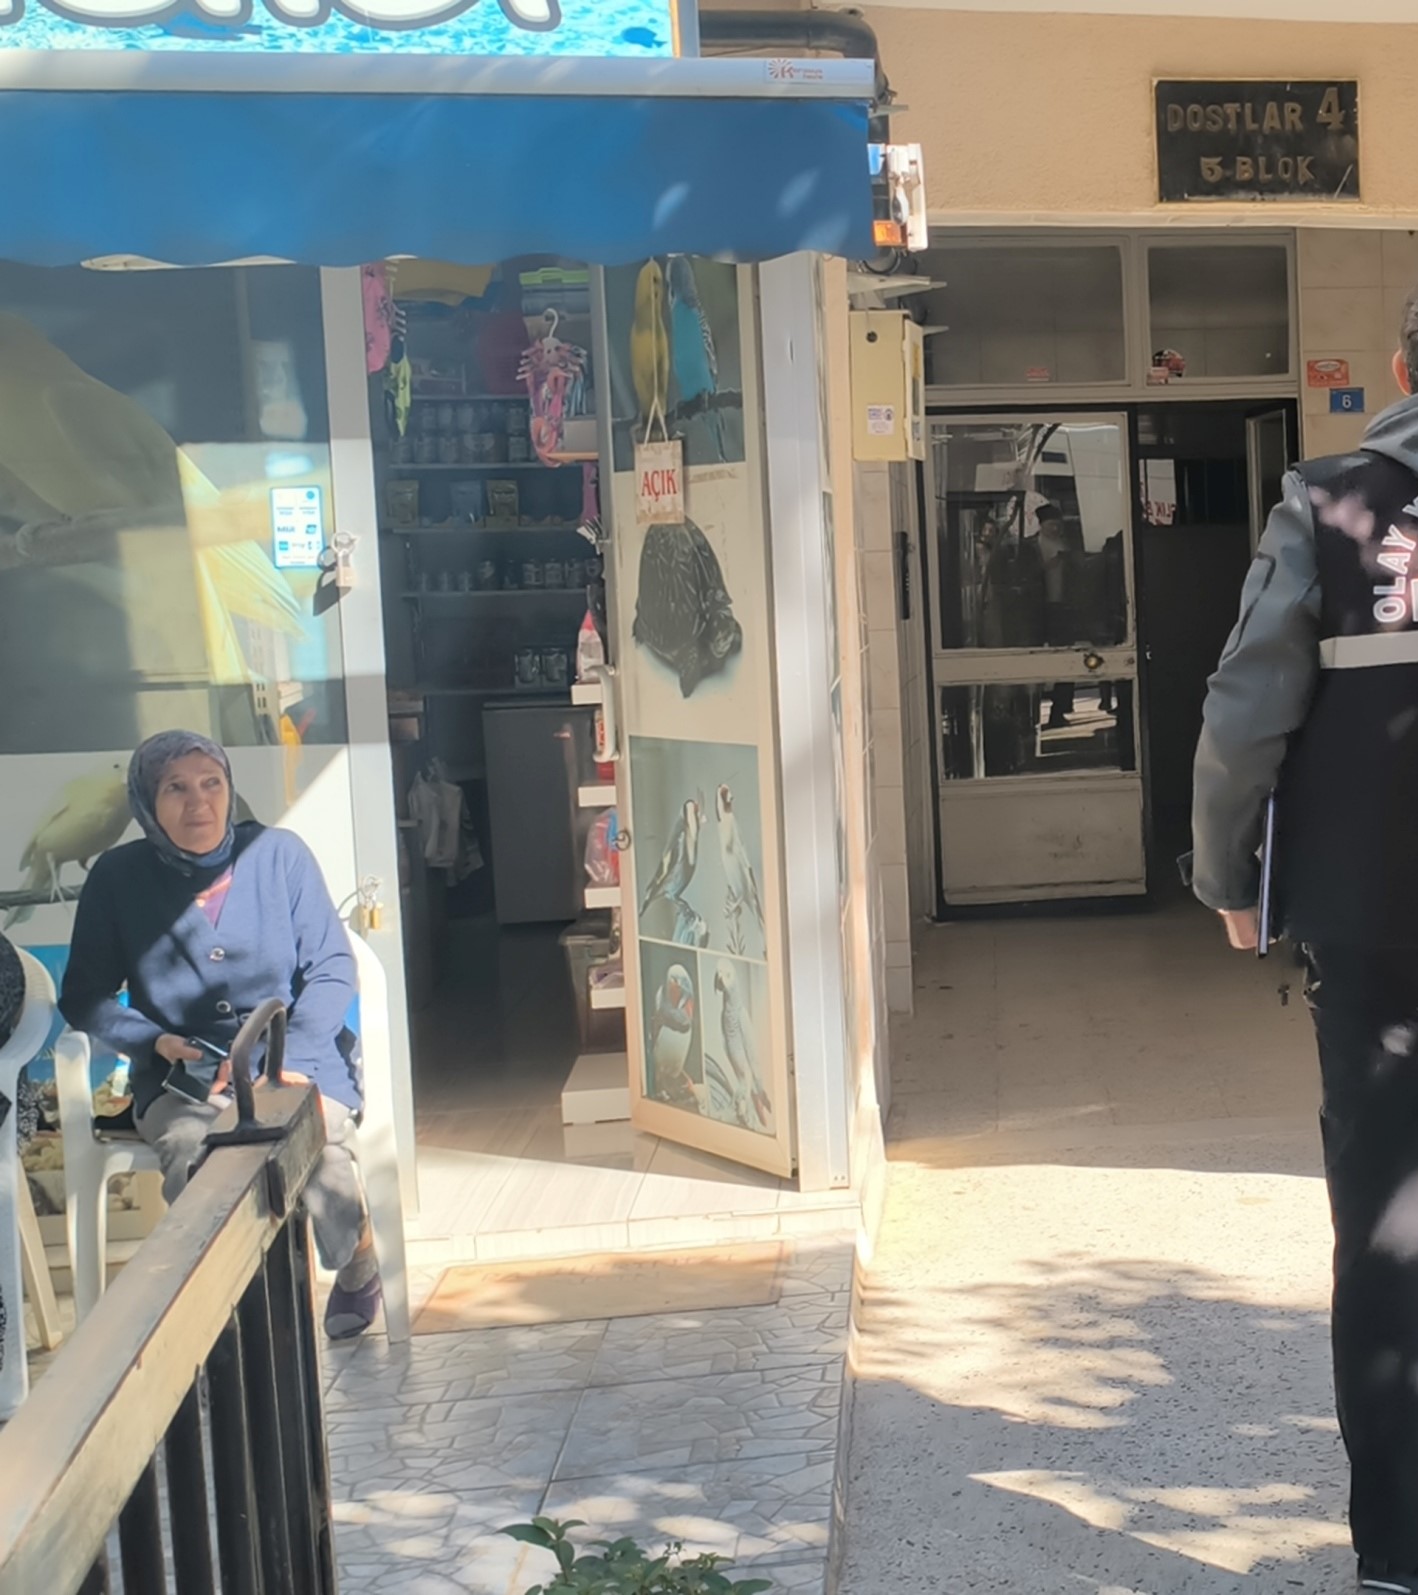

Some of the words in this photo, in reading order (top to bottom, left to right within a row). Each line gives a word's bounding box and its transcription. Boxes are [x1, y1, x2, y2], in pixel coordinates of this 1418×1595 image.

[1167, 102, 1303, 133] DOSTLAR
[1316, 87, 1345, 130] 4
[1342, 394, 1352, 408] 6
[641, 469, 677, 502] AÇIK
[1373, 524, 1416, 623] OLAY
